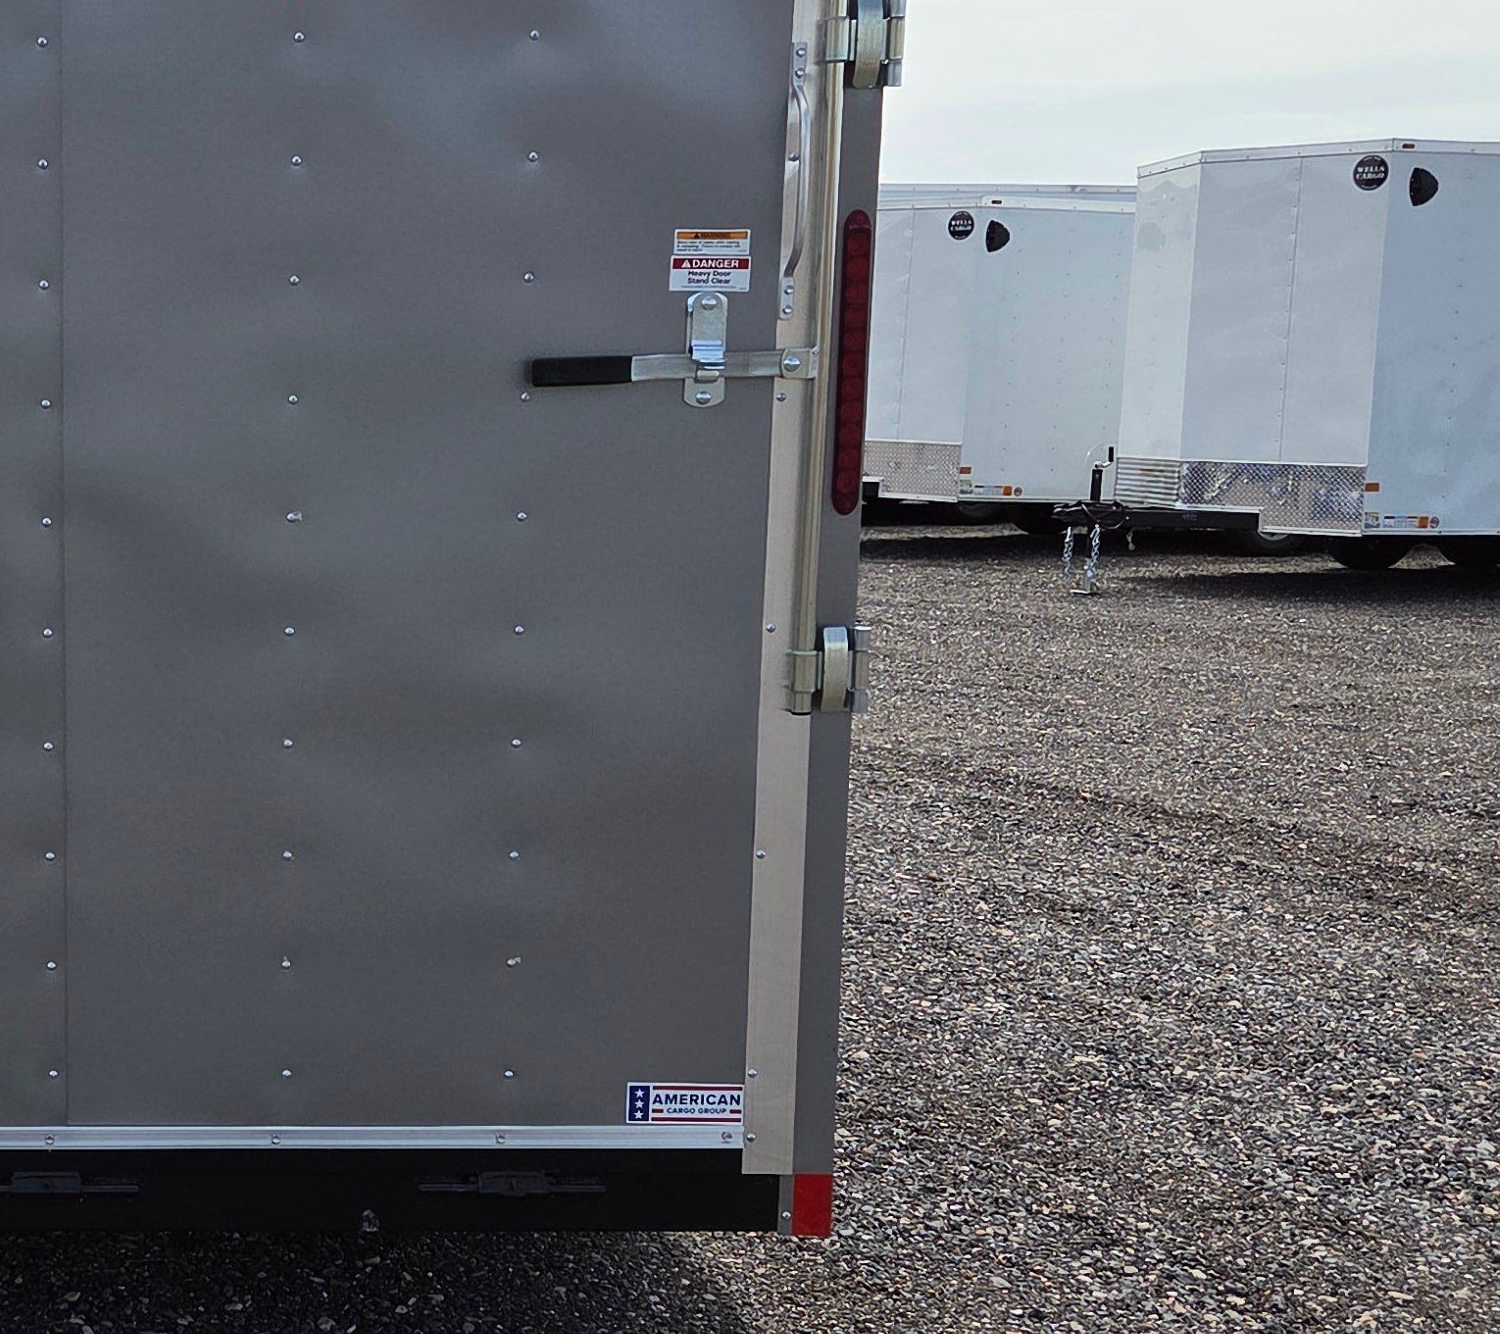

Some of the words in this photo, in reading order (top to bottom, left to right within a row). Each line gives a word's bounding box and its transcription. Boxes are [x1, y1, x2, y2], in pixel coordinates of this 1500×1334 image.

[692, 259, 740, 268] DANGER
[687, 270, 711, 278] Heavy
[652, 1093, 741, 1106] AMERICAN
[698, 1107, 727, 1115] GROUP
